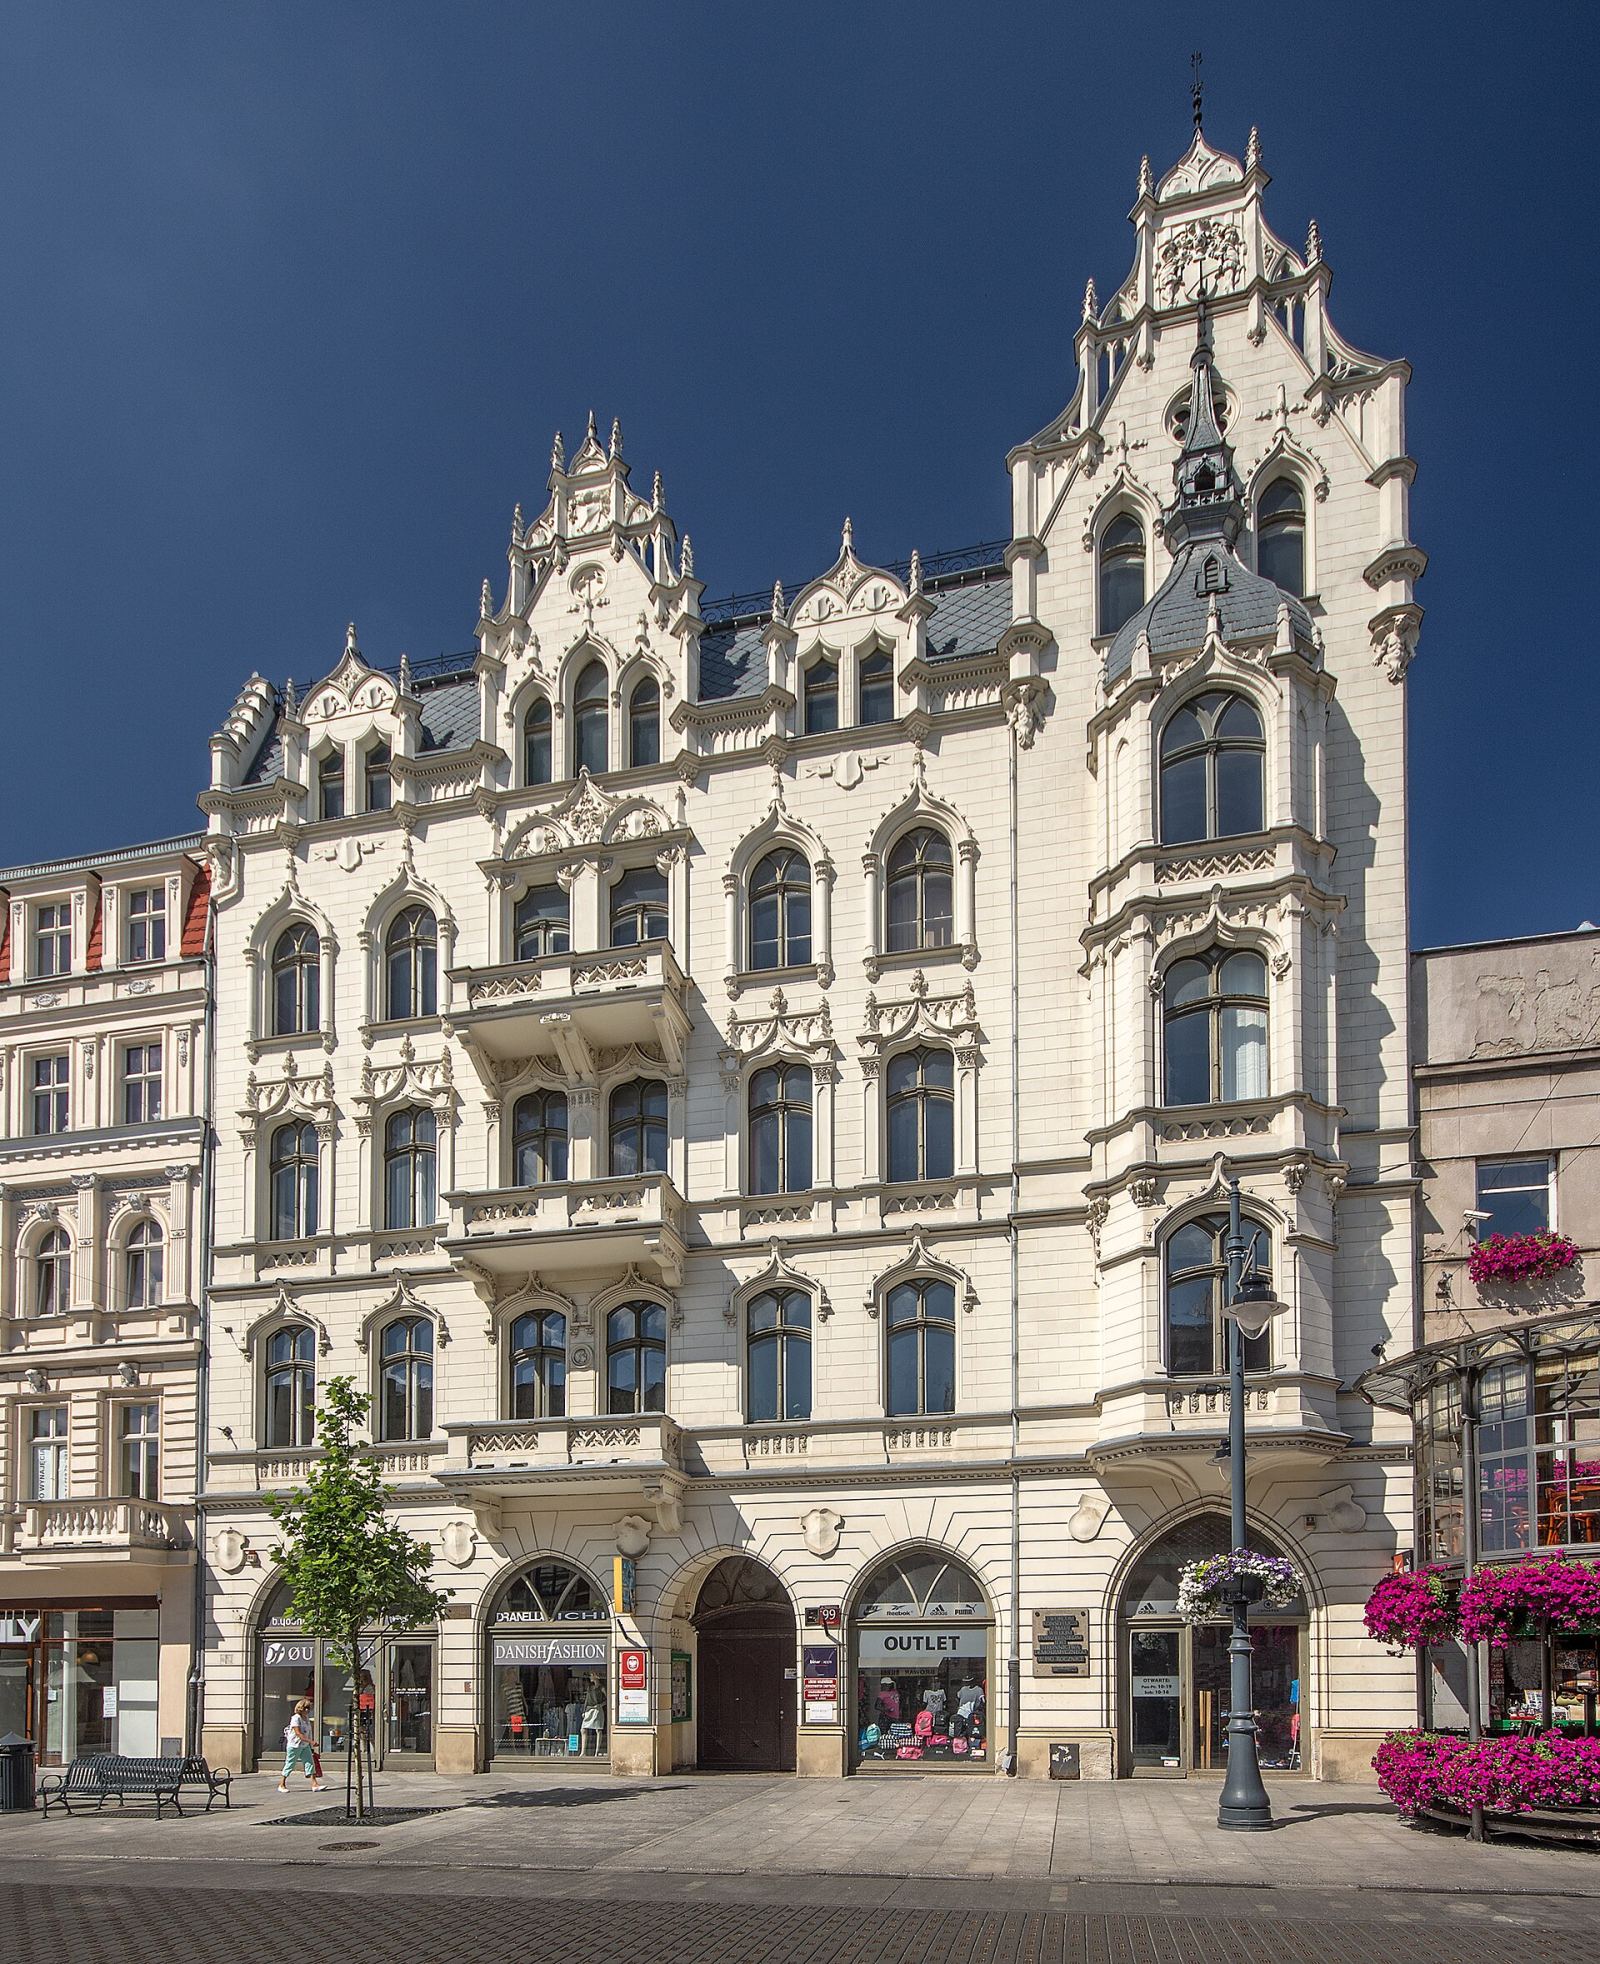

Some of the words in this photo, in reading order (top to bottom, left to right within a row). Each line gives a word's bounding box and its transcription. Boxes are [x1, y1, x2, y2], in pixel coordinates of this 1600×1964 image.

[557, 1611, 606, 1620] ICHI
[822, 1609, 836, 1621] 99
[0, 1618, 41, 1643] LY
[884, 1636, 960, 1651] OUTLET
